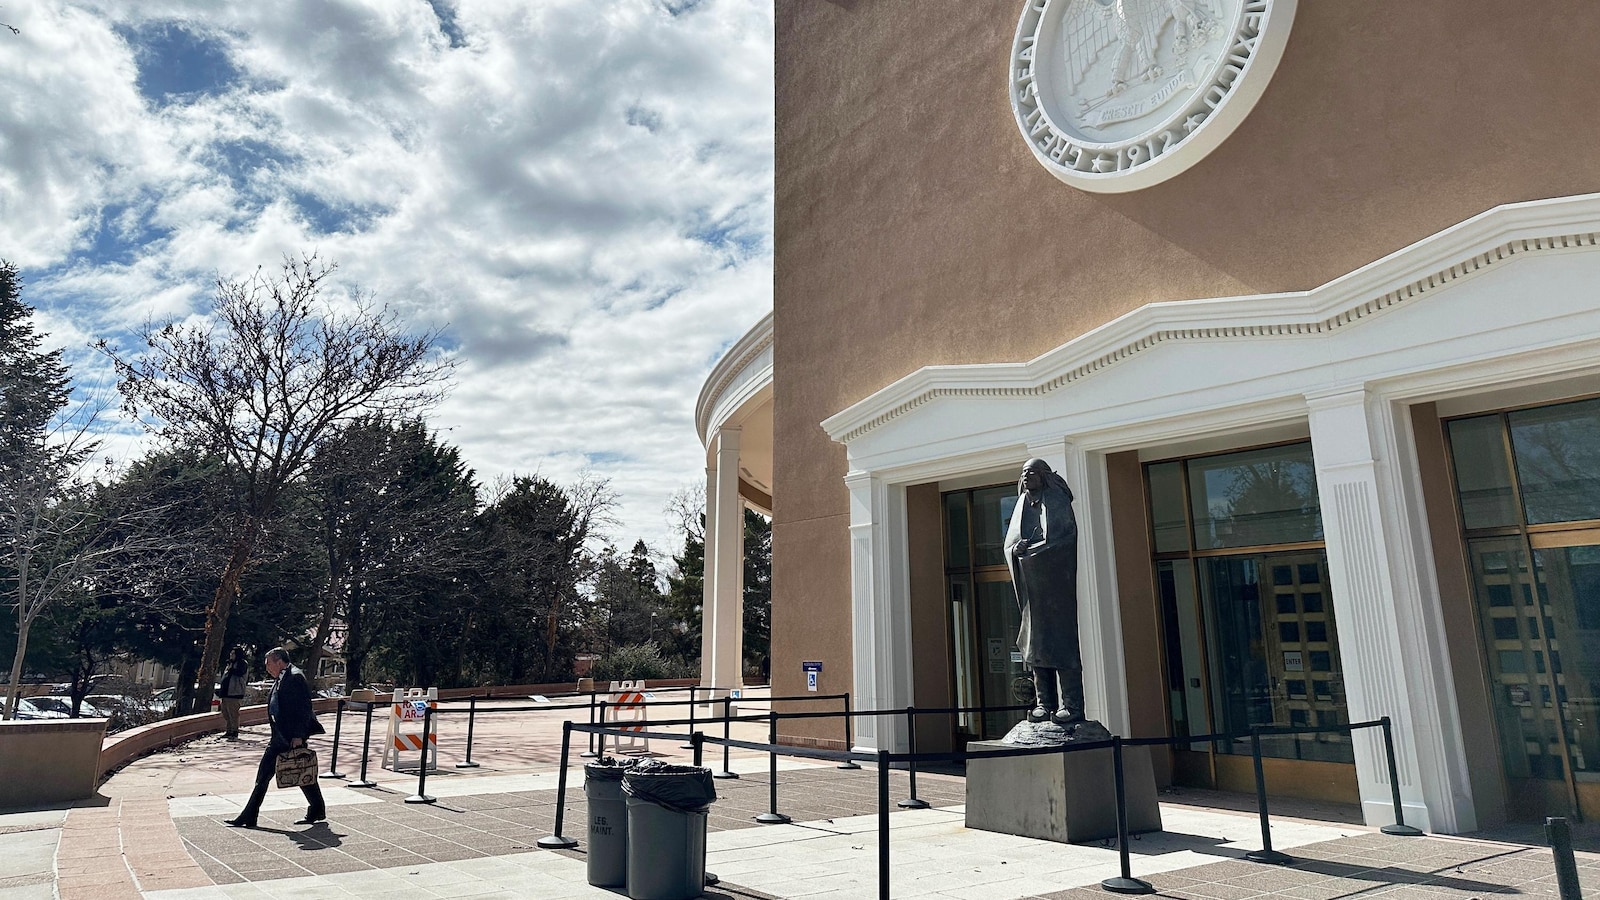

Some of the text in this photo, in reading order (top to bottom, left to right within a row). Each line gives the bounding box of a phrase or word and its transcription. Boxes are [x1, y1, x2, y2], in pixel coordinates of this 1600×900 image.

[1102, 101, 1144, 121] CRESCIT
[1024, 108, 1083, 170] GREAT
[1117, 130, 1176, 171] 1912
[590, 824, 614, 836] MAINT.
[594, 815, 608, 826] LEG.
